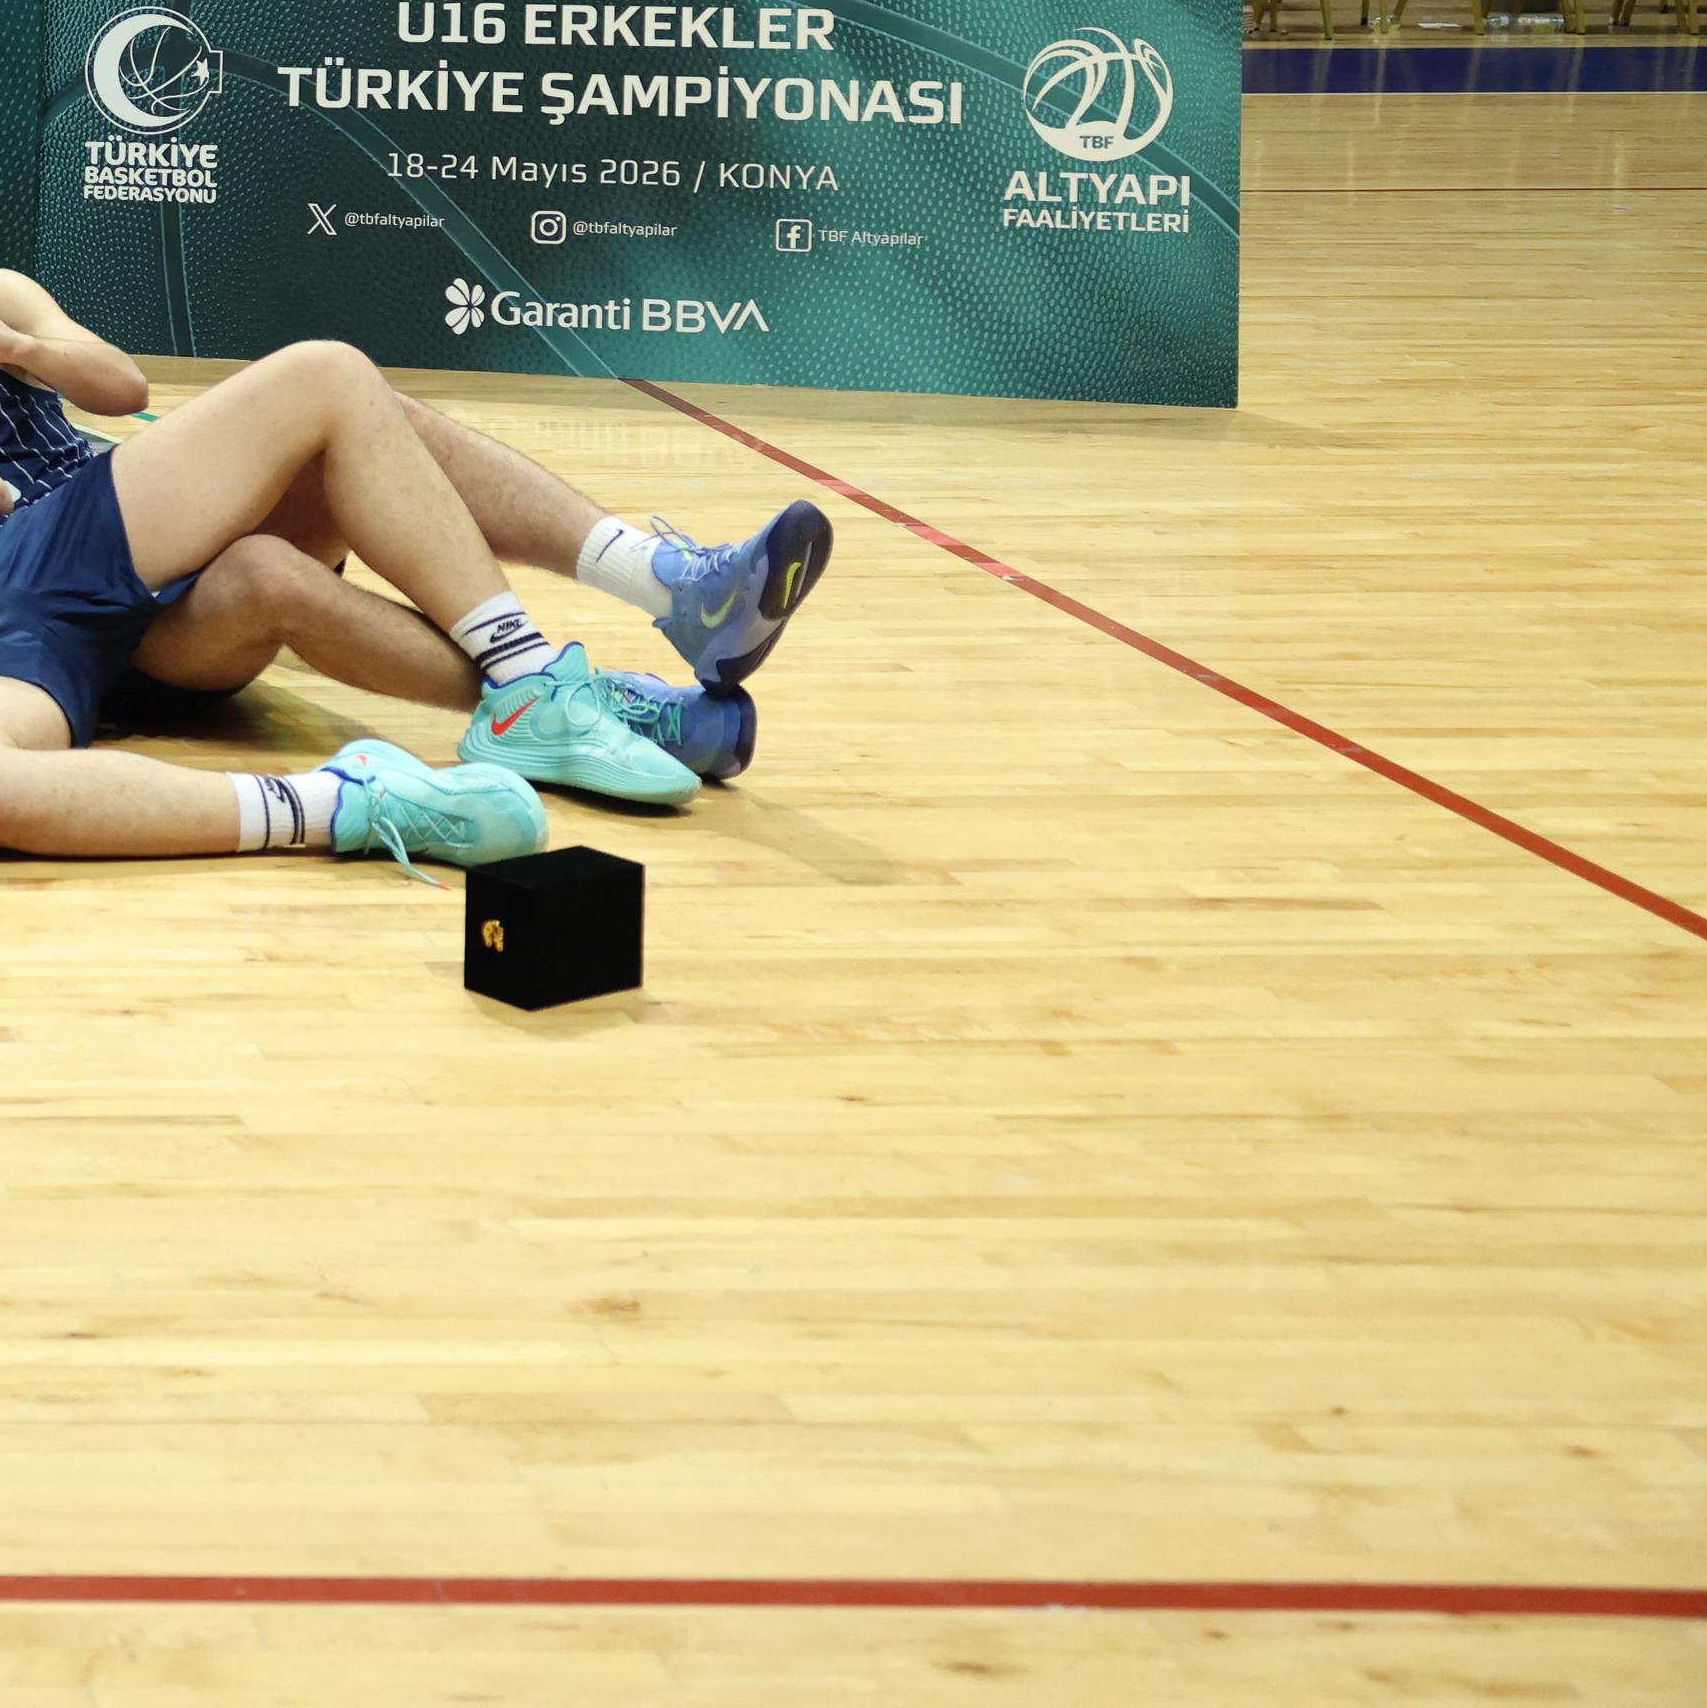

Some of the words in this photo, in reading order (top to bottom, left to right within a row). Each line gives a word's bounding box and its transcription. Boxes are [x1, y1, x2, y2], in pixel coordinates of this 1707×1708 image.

[398, 1, 506, 44] U16
[525, 3, 836, 51] ERKEKLER
[277, 56, 524, 113] TÜRKİYE
[542, 65, 963, 125] ŞAMPİYONASI
[85, 135, 218, 168] TÜRKİYE
[1079, 134, 1114, 150] TBF
[85, 167, 218, 189] BASKETBOL
[387, 152, 479, 179] 18-24
[492, 156, 587, 189] Mayıs
[600, 159, 681, 187] 2026
[719, 162, 840, 192] KONYA
[83, 185, 218, 204] FEDERASYONU
[1003, 170, 1191, 206] ALTYAPI
[344, 211, 445, 230] @tbfaltyapilar
[572, 219, 677, 240] @tbfaltyapilar
[1002, 205, 1190, 234] FAALİYETLERİ
[818, 229, 846, 243] TBF
[490, 290, 631, 330] Garanti
[642, 298, 770, 334] BBVA
[497, 619, 523, 633] NIKE
